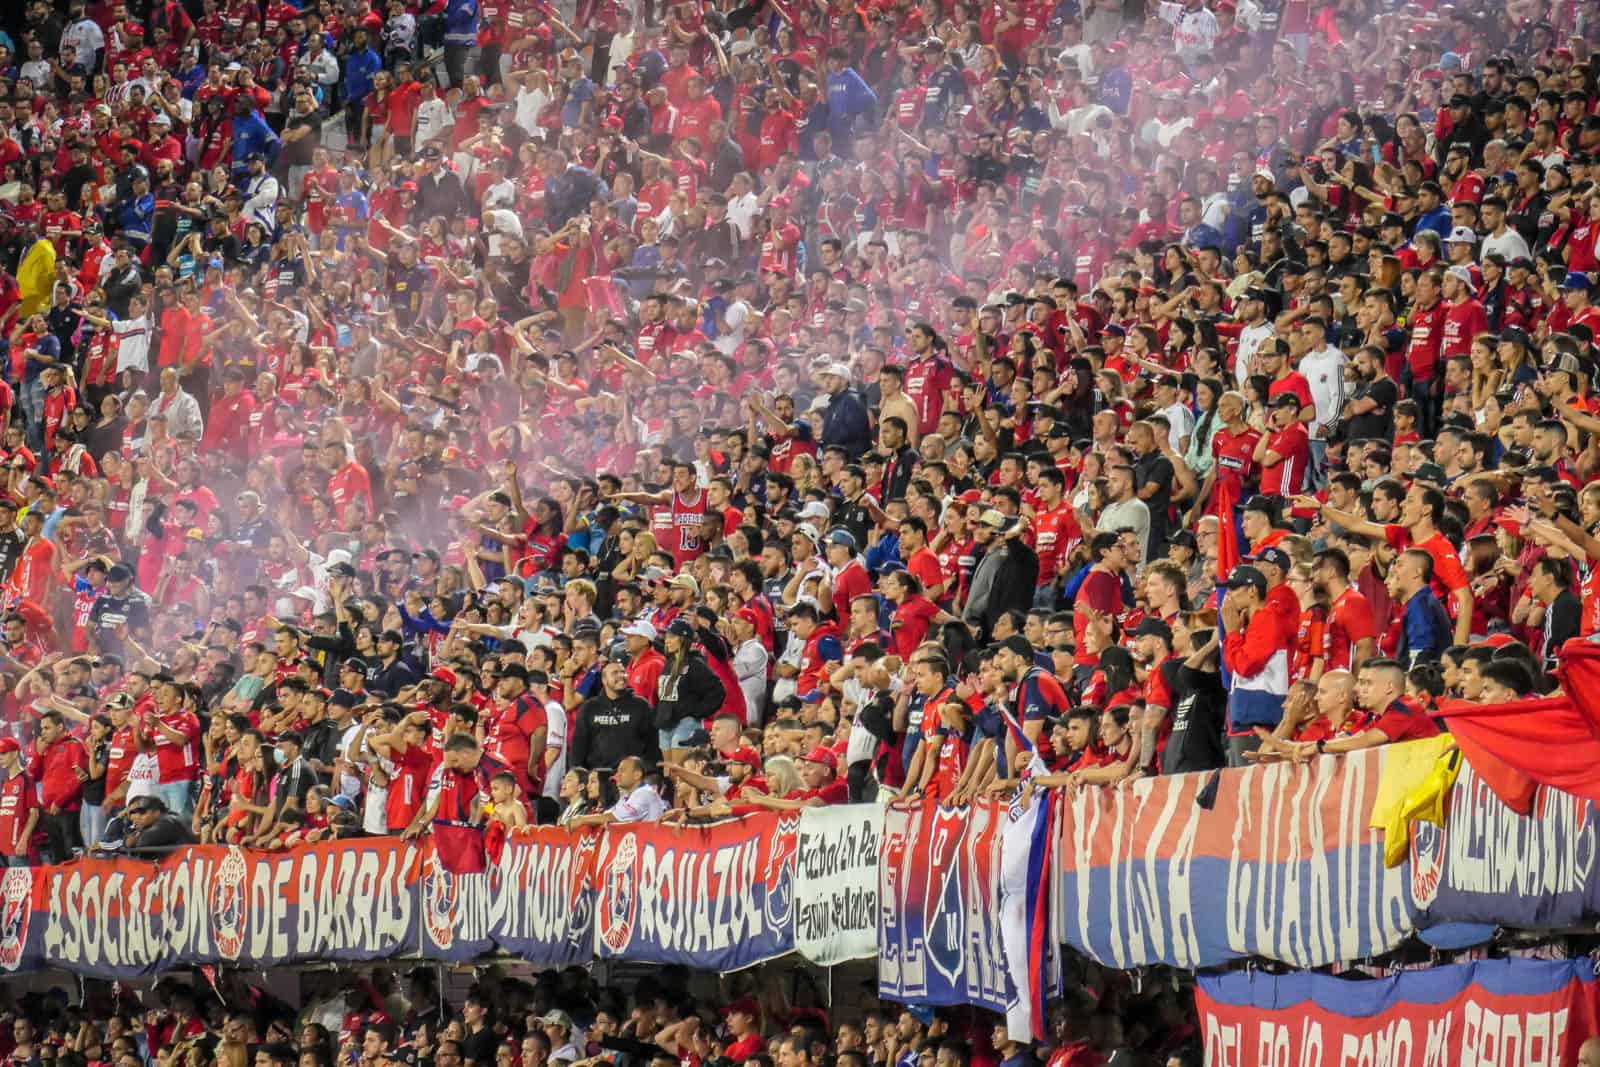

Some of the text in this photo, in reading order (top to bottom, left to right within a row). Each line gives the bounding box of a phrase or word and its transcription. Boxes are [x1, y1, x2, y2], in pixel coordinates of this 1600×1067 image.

[250, 856, 294, 960] DE
[298, 846, 418, 955] BARRAS
[640, 836, 763, 953] ROJIAZUL
